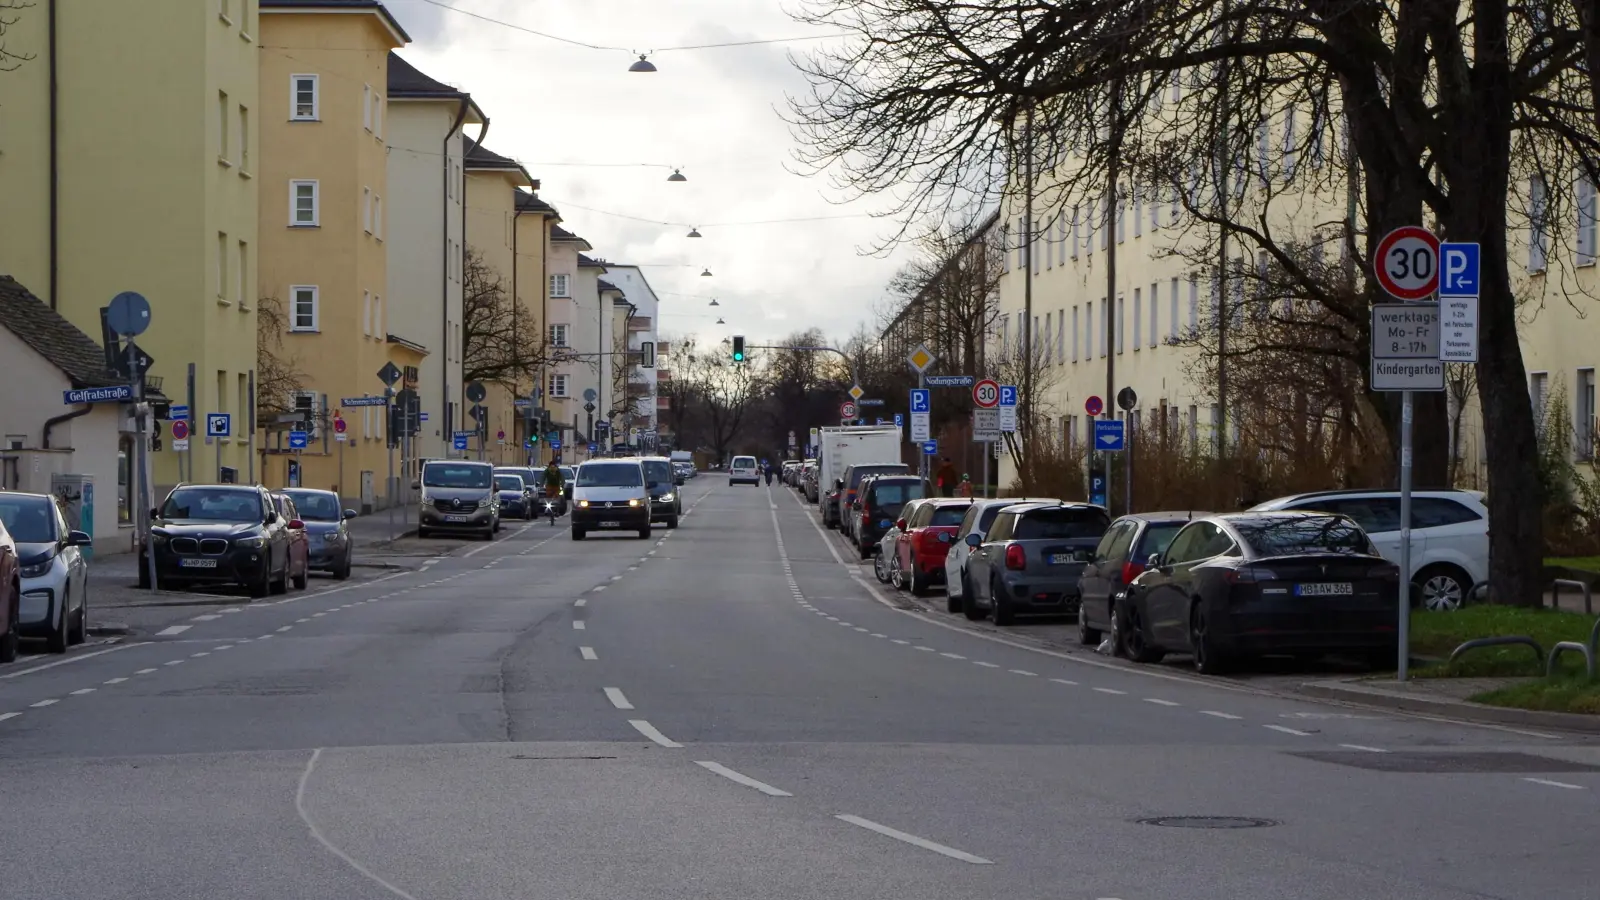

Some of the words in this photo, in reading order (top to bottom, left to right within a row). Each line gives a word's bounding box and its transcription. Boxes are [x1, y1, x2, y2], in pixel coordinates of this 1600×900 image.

[1390, 248, 1431, 279] 30
[1446, 250, 1467, 288] P
[1381, 312, 1438, 325] werktags
[1376, 363, 1440, 377] Kindergarten
[926, 377, 972, 385] Nodungstraße
[70, 388, 128, 402] Gelfratstraße
[979, 387, 995, 399] 30
[1002, 388, 1012, 403] P
[913, 392, 924, 410] P
[1093, 478, 1102, 490] P
[1300, 584, 1313, 594] MB
[1319, 584, 1332, 594] AW
[1334, 583, 1352, 594] 36E
